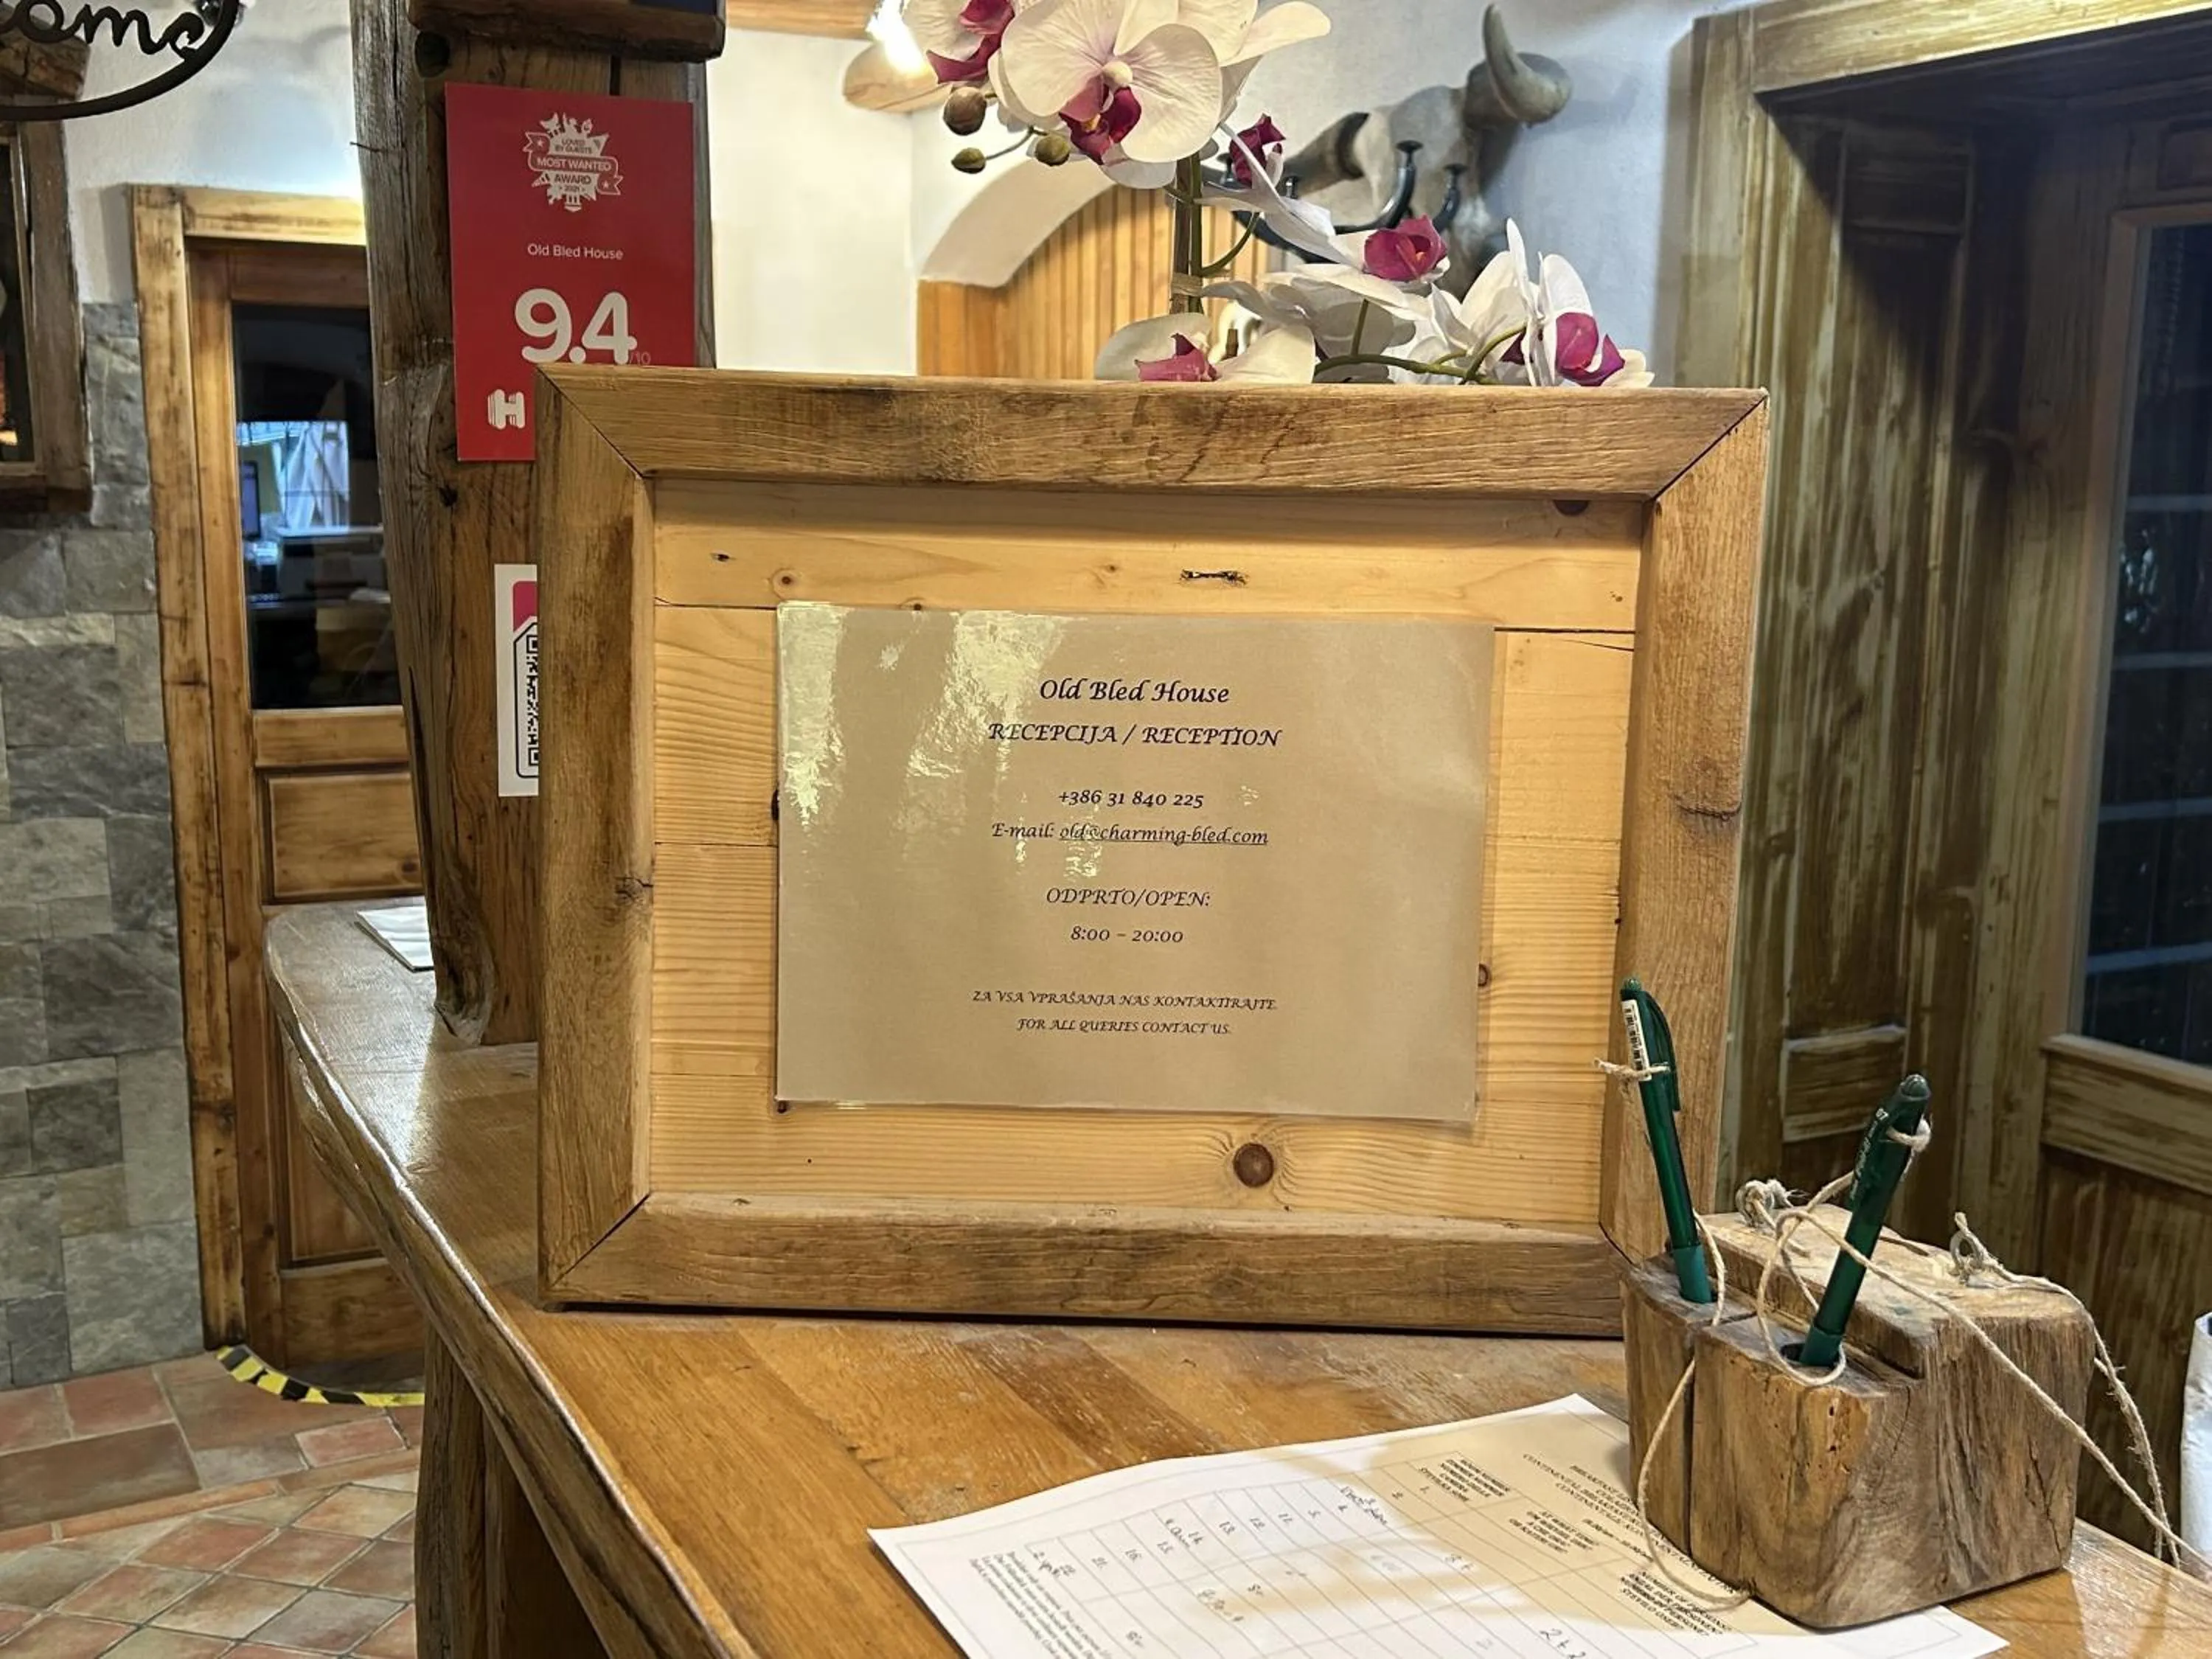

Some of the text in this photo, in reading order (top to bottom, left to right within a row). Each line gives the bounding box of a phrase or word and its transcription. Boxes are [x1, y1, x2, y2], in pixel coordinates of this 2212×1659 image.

[537, 157, 611, 171] MOST WANTED
[554, 174, 591, 184] AWARD
[527, 243, 623, 260] Old Bled House
[515, 288, 637, 364] 9.4
[1040, 678, 1230, 703] Old Bled House
[988, 723, 1281, 747] RECEPCIJA / RECEPTION
[1057, 789, 1204, 809] +386 31 840 225
[992, 822, 1269, 846] E-mail: old@charming-bled.com
[1046, 887, 1211, 908] ODPRTO/OPEN:
[1070, 926, 1110, 942] 8:00
[1131, 929, 1184, 943] 20:00
[972, 990, 992, 1002] ZA
[996, 990, 1024, 1004] VSA
[1119, 995, 1150, 1006] NAS
[1017, 1018, 1046, 1031] FOR
[1049, 1019, 1076, 1031] ALL
[1079, 1020, 1139, 1033] QUERIES
[1142, 1021, 1208, 1034] CONTACT
